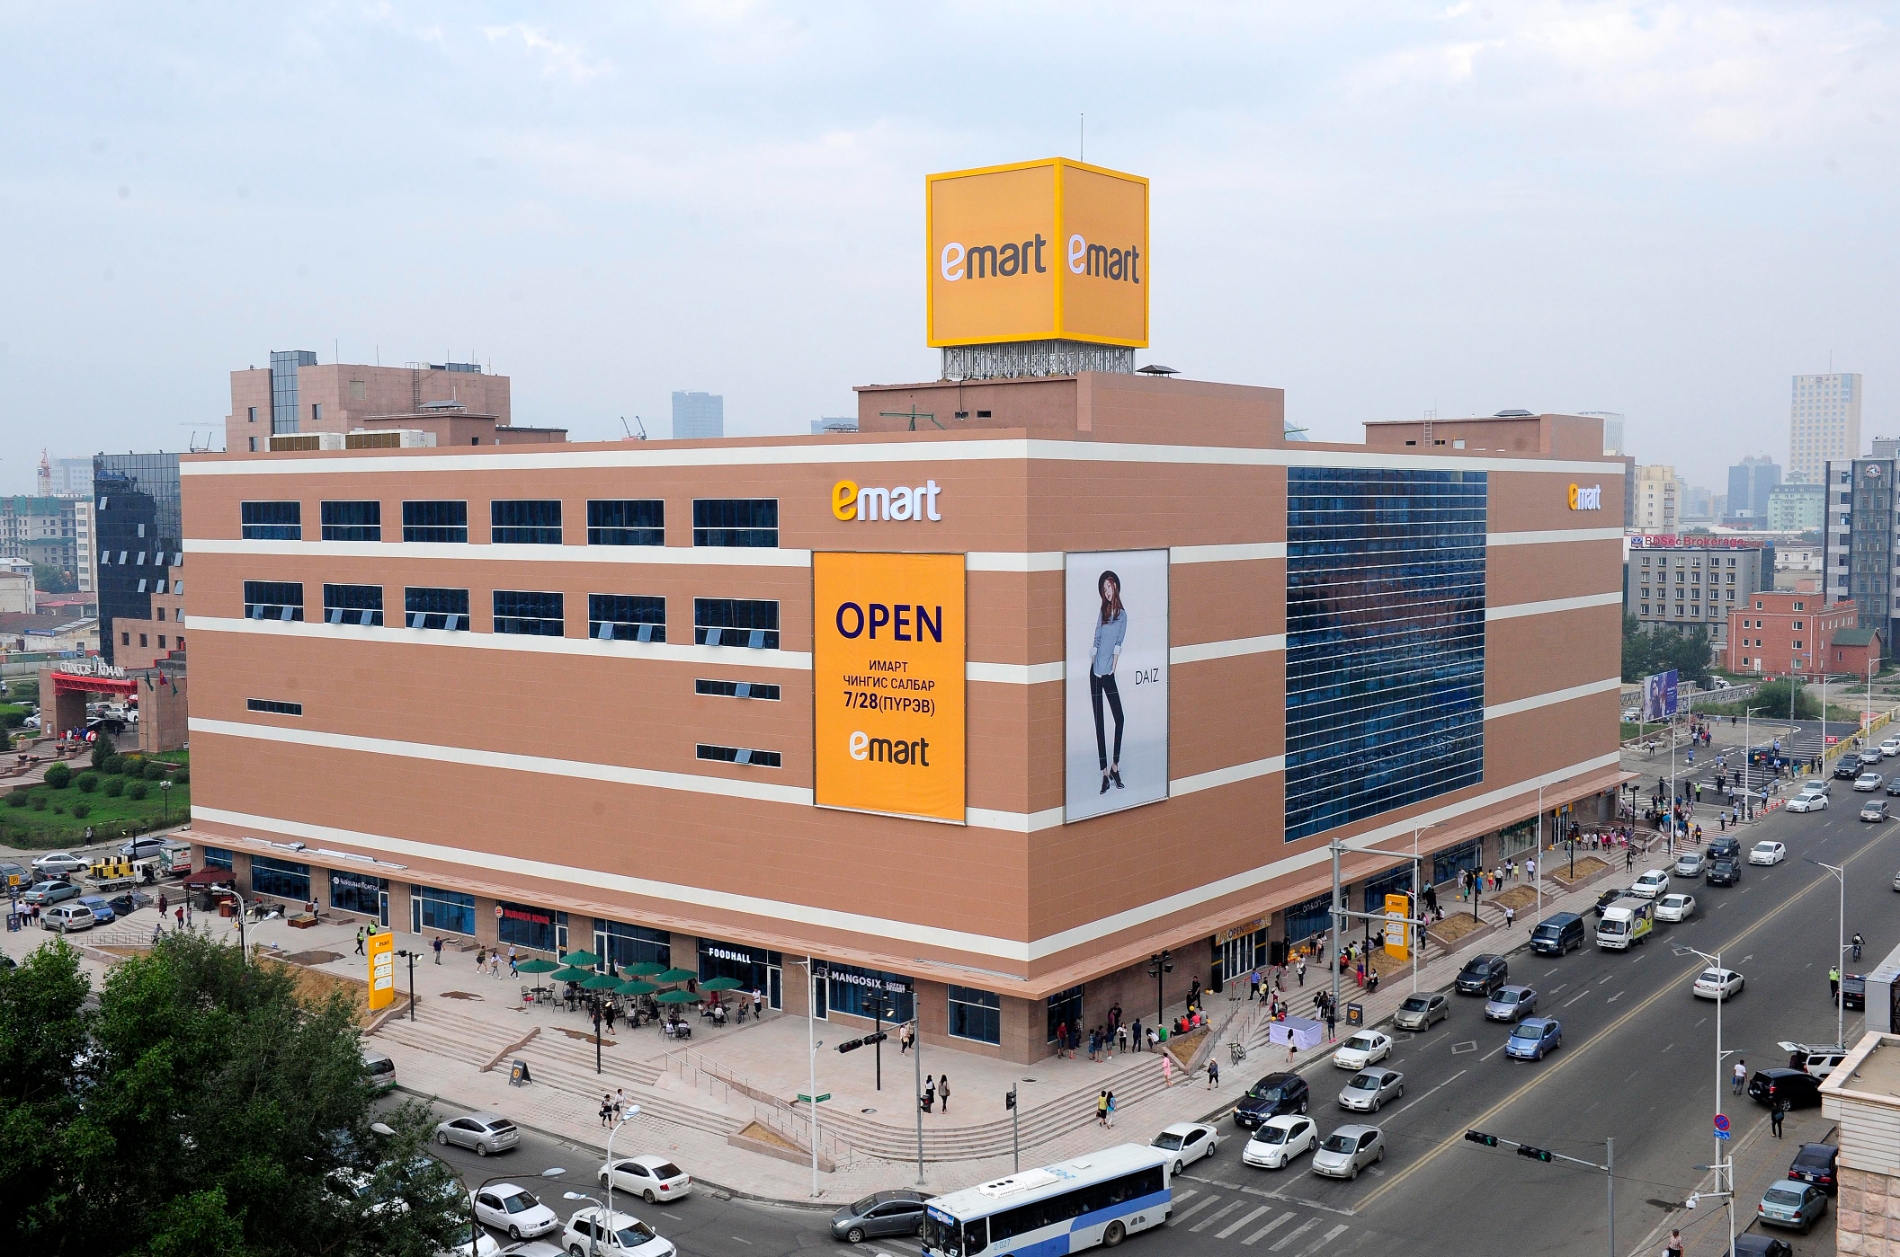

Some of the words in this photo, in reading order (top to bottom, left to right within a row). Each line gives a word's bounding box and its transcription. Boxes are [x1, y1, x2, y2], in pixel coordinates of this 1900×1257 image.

[941, 233, 1046, 281] emart
[1068, 233, 1140, 284] emart
[831, 479, 942, 521] emart
[1567, 483, 1601, 511] emart
[1645, 536, 1682, 546] BDSec
[1683, 536, 1744, 547] Brokerage
[835, 601, 943, 643] OPEN
[869, 659, 908, 672] ИМАРТ
[1135, 668, 1159, 685] DAIZ
[843, 674, 888, 688] ЧИНГИС
[891, 678, 935, 691] САЛБАР
[849, 730, 930, 767] emart
[708, 947, 752, 963] FOODHALL
[831, 970, 882, 989] MANGOSIX
